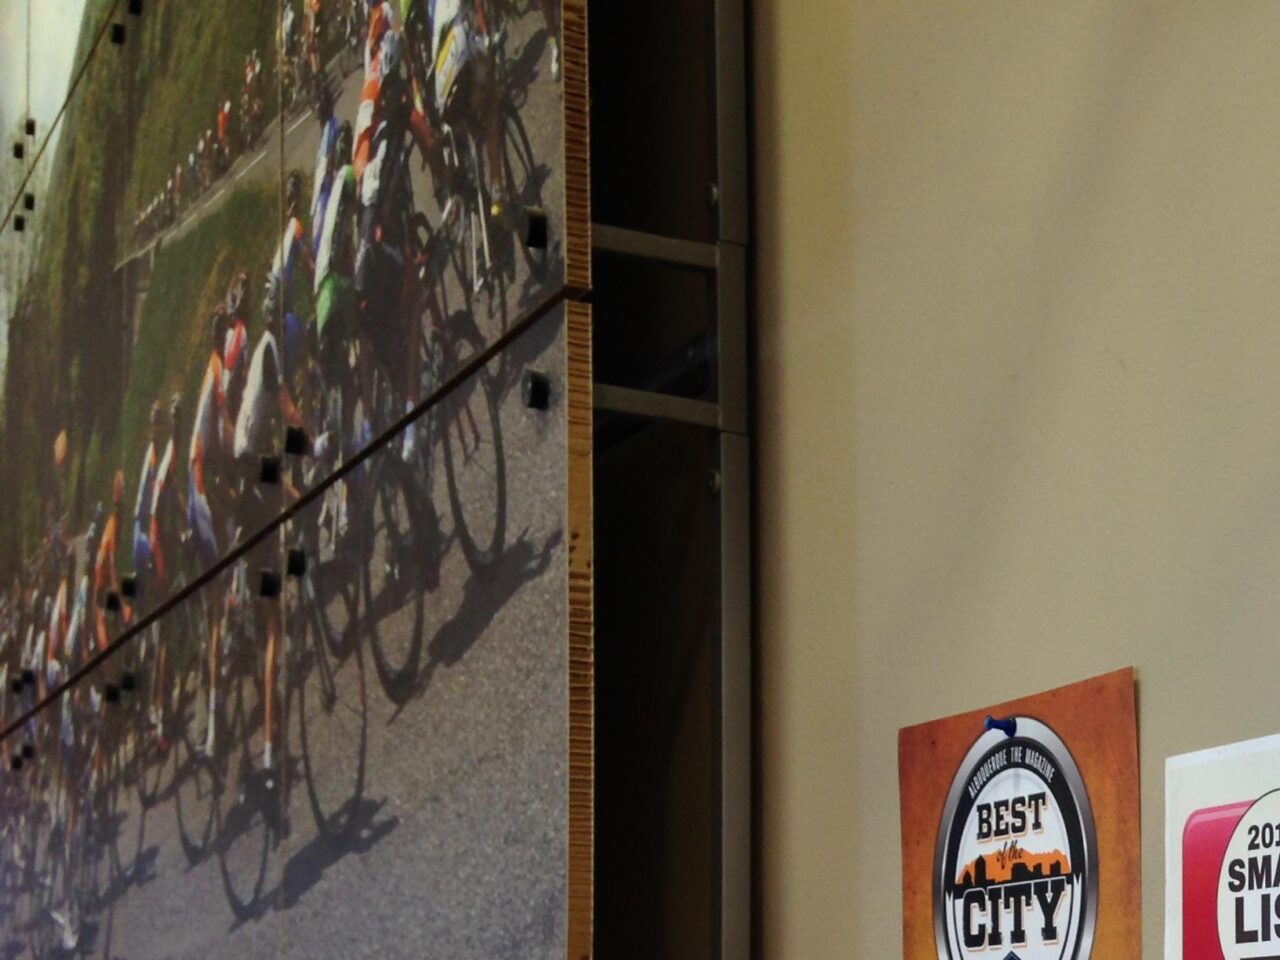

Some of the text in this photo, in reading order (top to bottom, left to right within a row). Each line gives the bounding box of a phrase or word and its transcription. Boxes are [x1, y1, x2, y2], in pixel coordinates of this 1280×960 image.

[1010, 746, 1023, 763] THE
[1024, 747, 1056, 783] MAGAZINE
[976, 792, 1047, 841] BEST
[996, 839, 1024, 869] of the
[962, 876, 1068, 949] CITY
